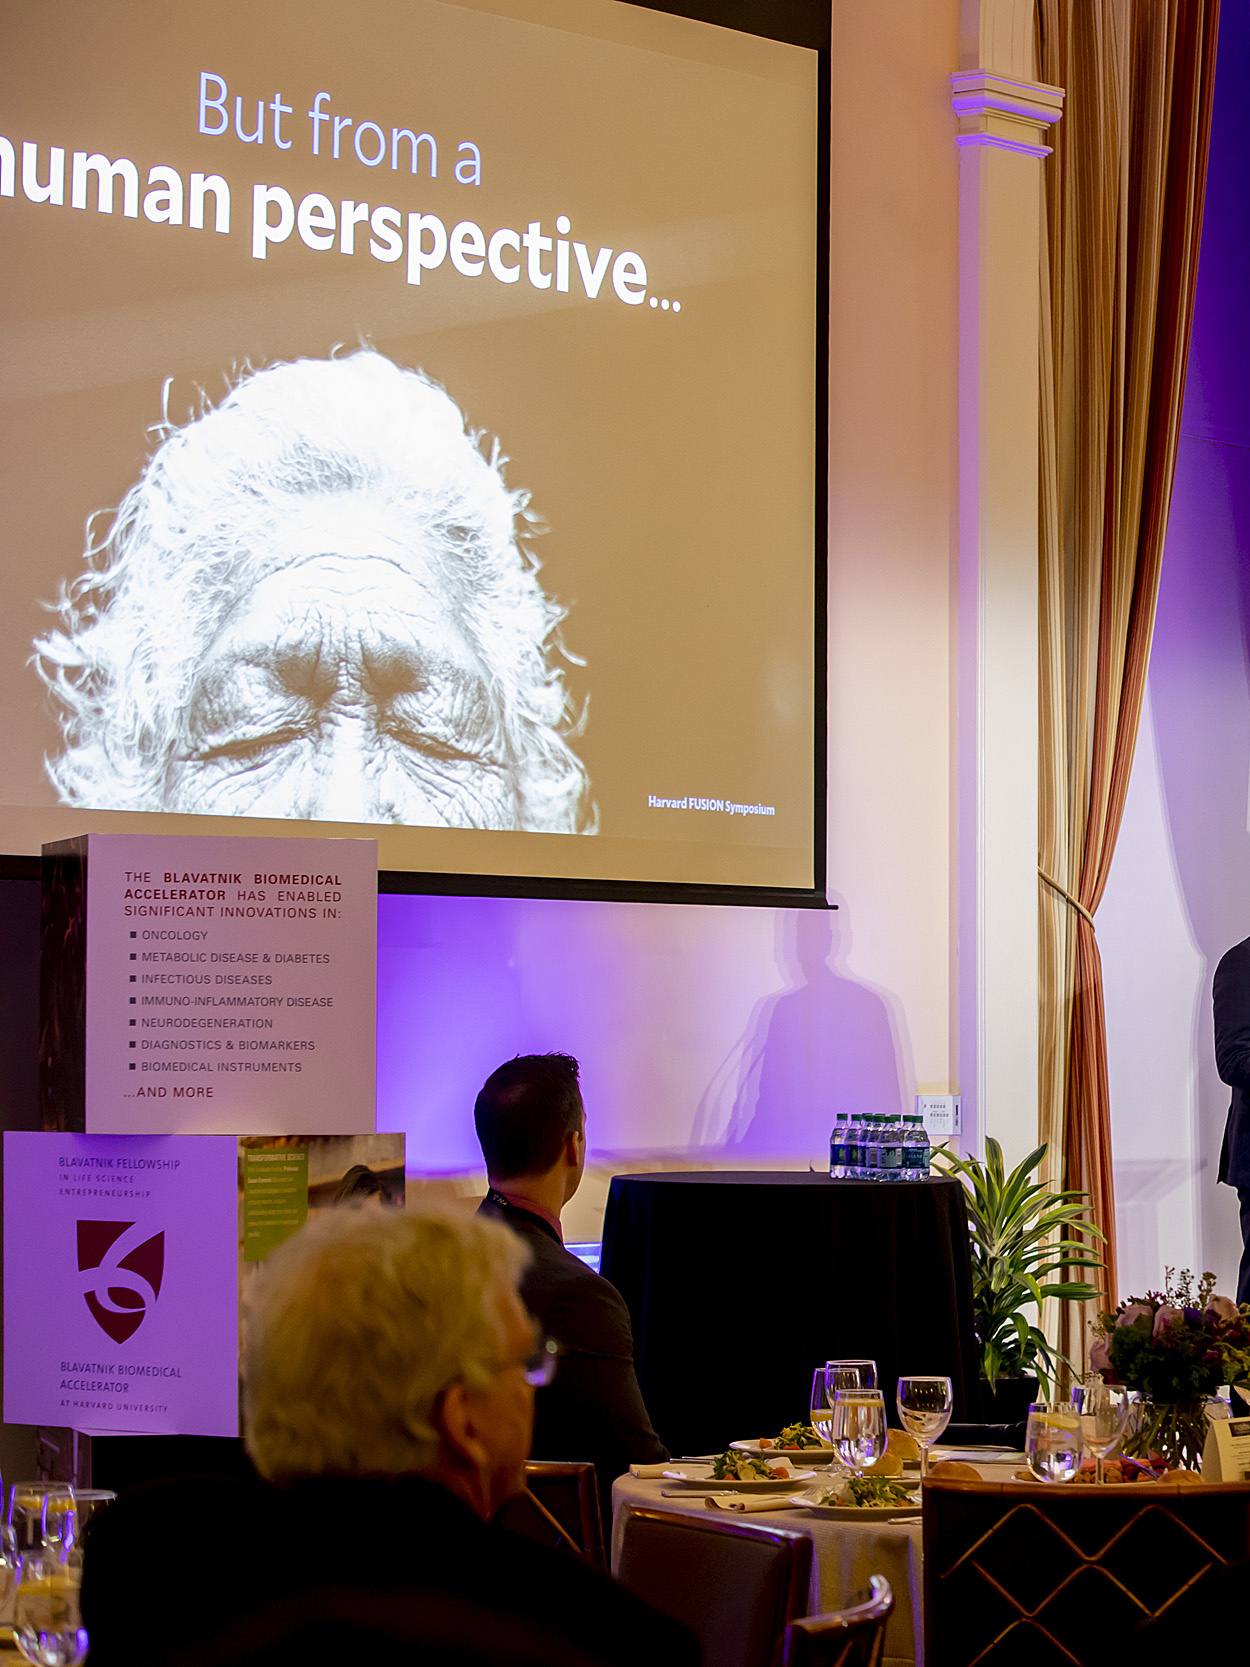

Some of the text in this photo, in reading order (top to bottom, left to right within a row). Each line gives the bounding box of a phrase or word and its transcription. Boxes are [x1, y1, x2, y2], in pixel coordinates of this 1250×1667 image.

[199, 71, 481, 186] But from a
[252, 184, 681, 313] perspective...
[648, 795, 775, 816] Harvard FUSION Symposium
[125, 872, 342, 885] THE BLAVATNIK BIOMEDICAL
[124, 889, 342, 902] ACCELERATOR HAS ENABLED
[124, 906, 342, 919] SIGNIFICANT INNOVATIONS IN:
[142, 931, 208, 940] ONCOLOGY
[142, 953, 330, 964] METABOLIC DISEASE & DIABETES
[142, 974, 273, 985] INFECTIOUS DISEASES
[142, 996, 334, 1008] IMMUNO-INFLAMMATORY DISEASE
[142, 1018, 273, 1028] NEURODEGENERATION
[142, 1040, 316, 1050] DIAGNOSTICS & BIOMARKERS
[142, 1062, 302, 1072] BIOMEDICAL INSTRUMENTS
[123, 1087, 214, 1098] ...AND MORE
[58, 1157, 180, 1170] BLAVATNIK FELLOWSHIP
[73, 1174, 92, 1182] LIFE
[96, 1175, 134, 1184] SCIENCE
[59, 1188, 151, 1198] ENTREPRENEURSHIP
[60, 1362, 182, 1378] BLAVATNIK BIOMEDICAL
[60, 1380, 129, 1393] ACCELERATOR
[73, 1401, 114, 1410] HARVARD
[116, 1404, 168, 1413] UNIVERSITY
